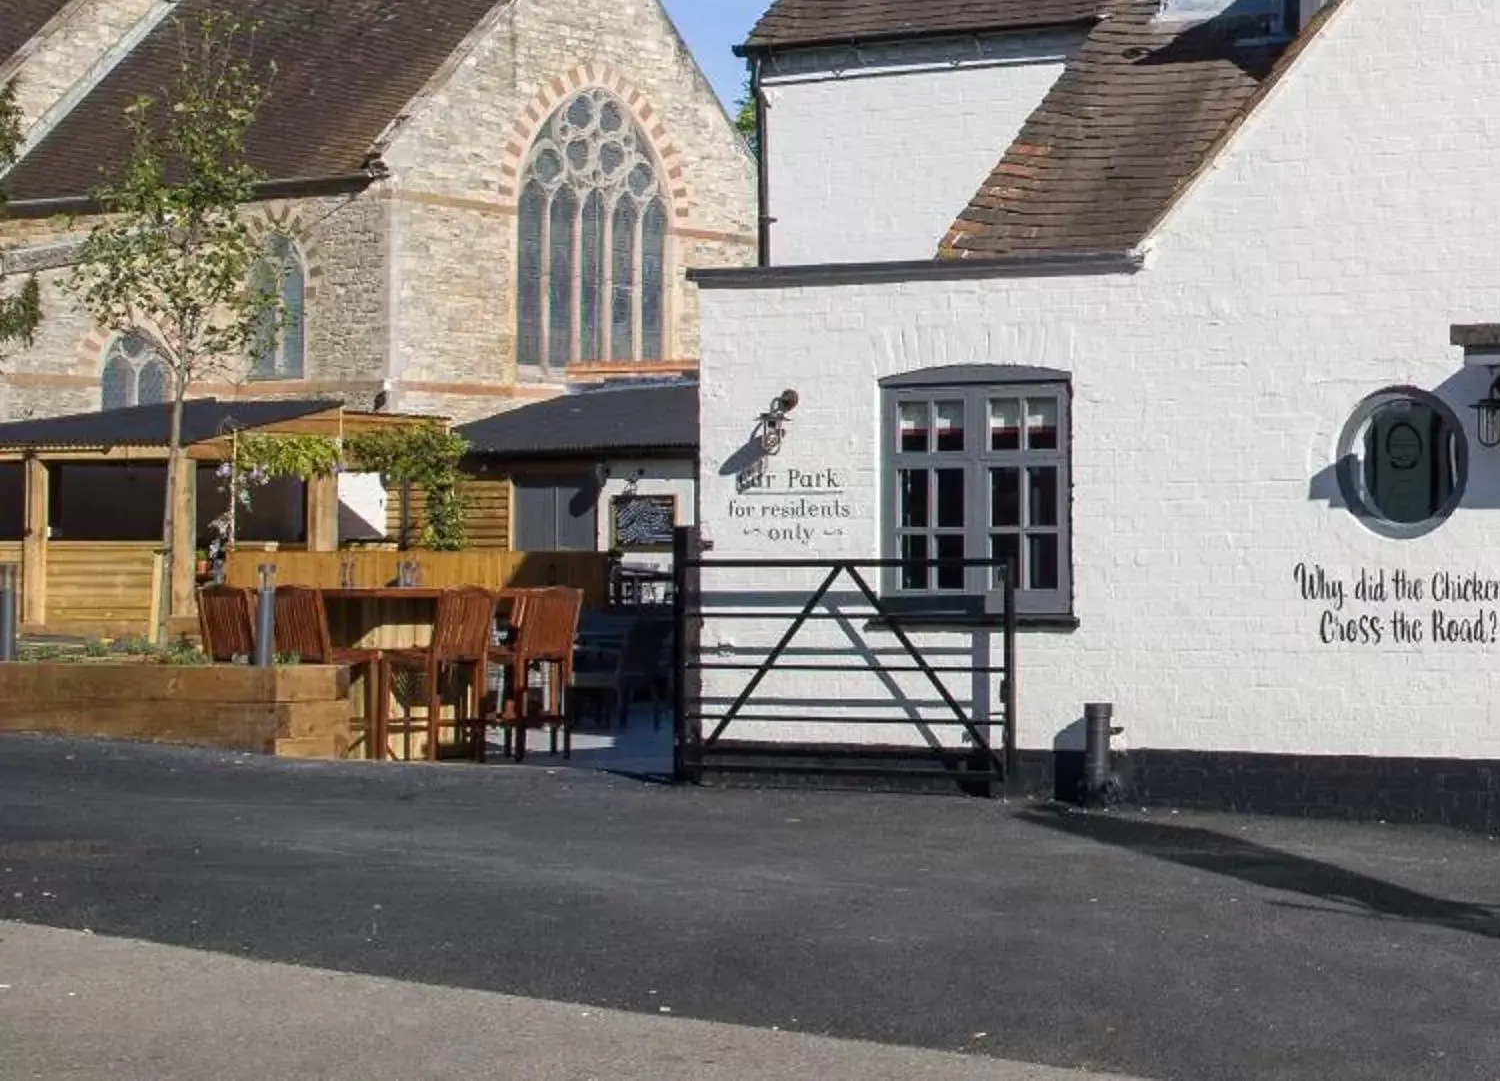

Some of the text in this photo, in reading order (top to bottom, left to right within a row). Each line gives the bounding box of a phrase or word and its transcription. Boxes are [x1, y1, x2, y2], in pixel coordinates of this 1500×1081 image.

[788, 467, 841, 489] Park
[728, 497, 851, 518] for residents
[767, 523, 815, 545] only
[1294, 562, 1347, 611] Why
[1355, 567, 1389, 603] did
[1391, 568, 1424, 603] the
[1319, 607, 1498, 645] Cross the Road?
